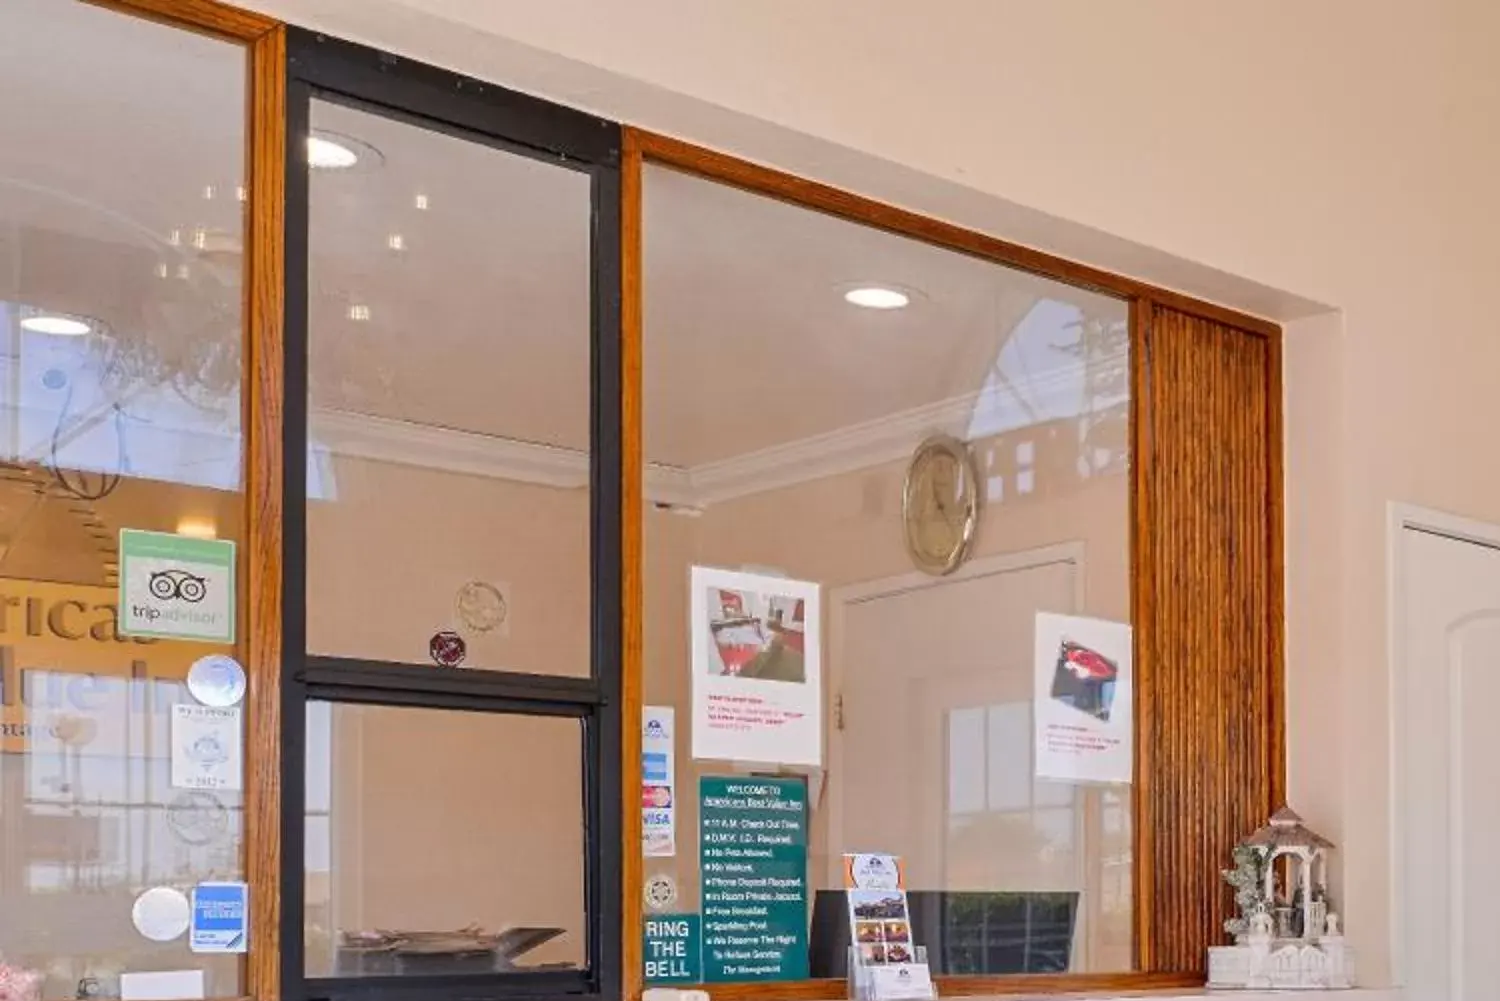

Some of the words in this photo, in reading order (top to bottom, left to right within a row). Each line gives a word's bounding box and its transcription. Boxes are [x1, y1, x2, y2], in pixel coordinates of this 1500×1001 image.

[643, 812, 671, 826] VISA
[645, 921, 690, 939] RING
[649, 940, 687, 958] THE
[644, 959, 691, 978] BELL
